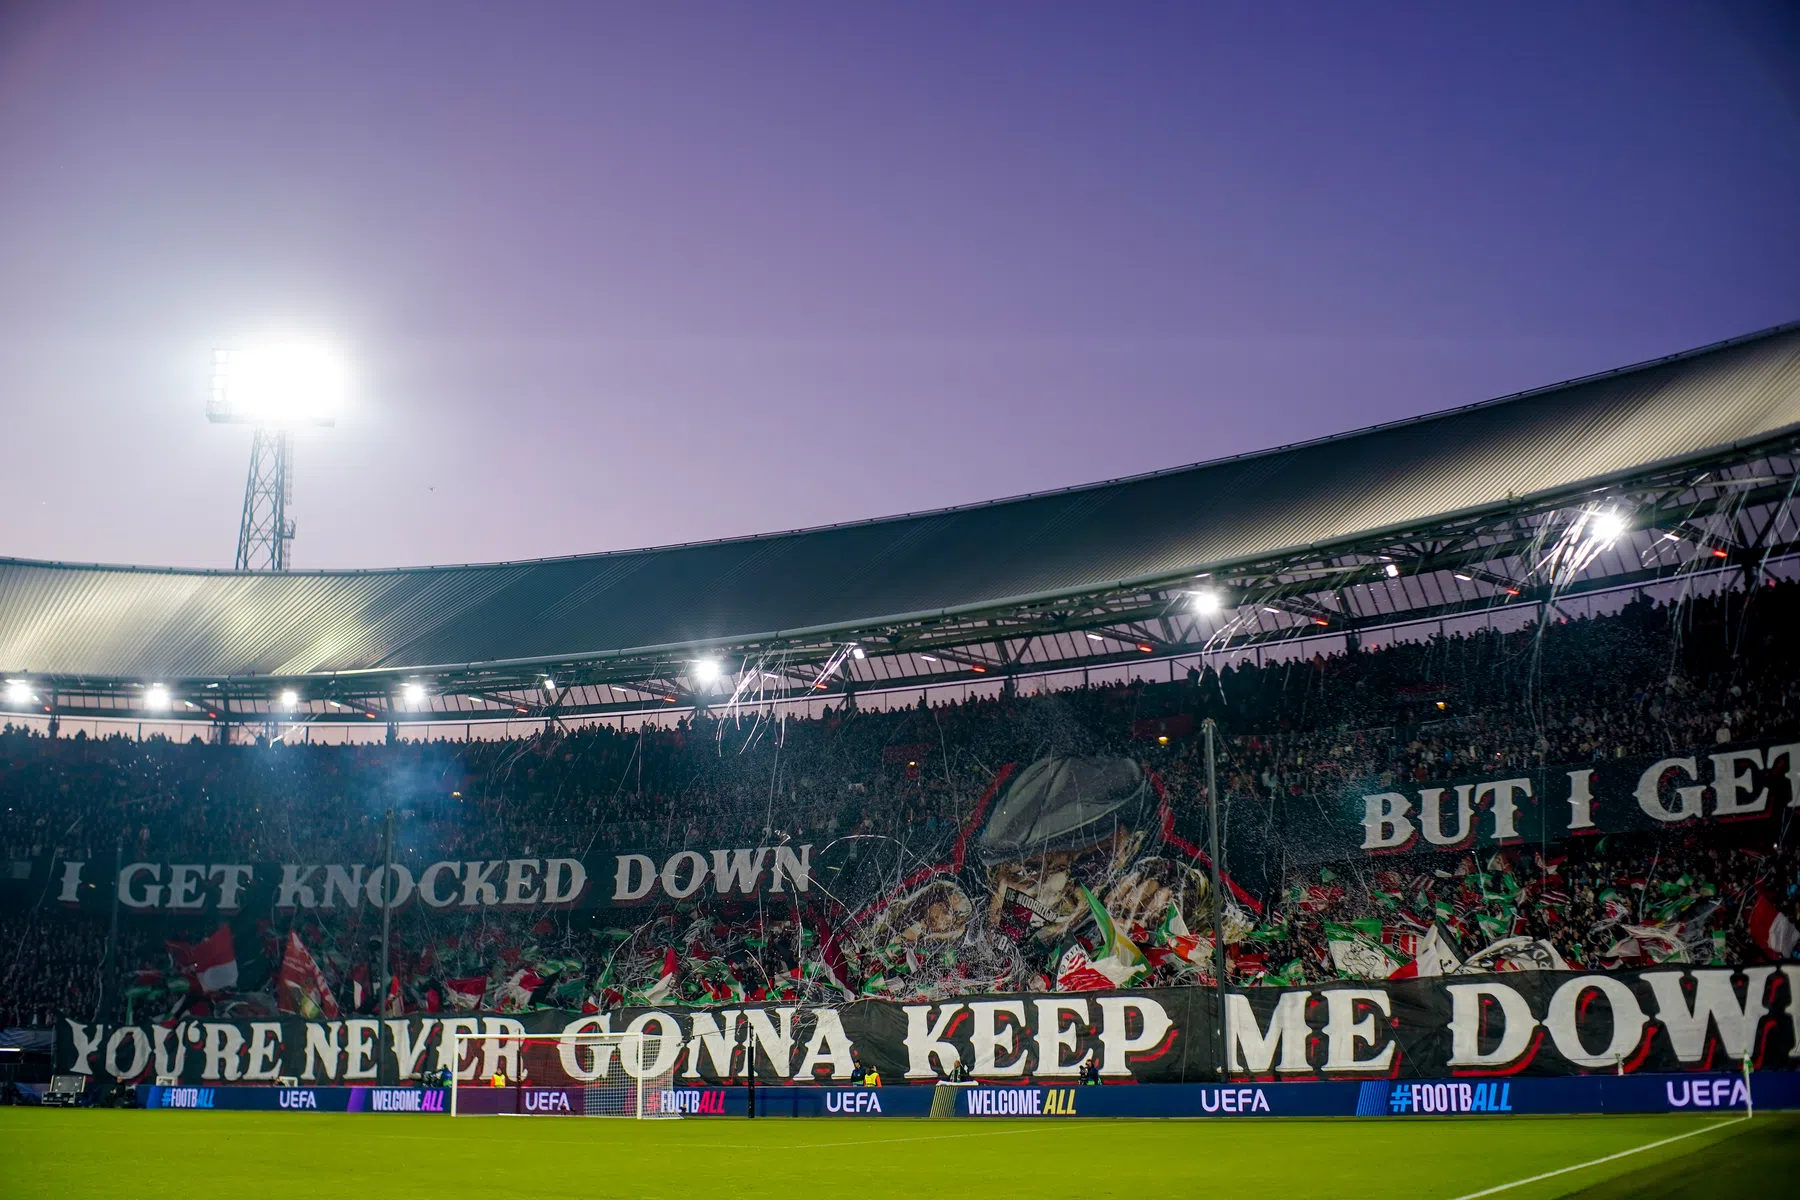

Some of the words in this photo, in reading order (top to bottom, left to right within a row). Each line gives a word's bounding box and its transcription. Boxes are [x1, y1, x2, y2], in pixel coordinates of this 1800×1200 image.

[1360, 777, 1533, 849] BUT
[1567, 769, 1594, 831] I
[57, 861, 86, 902] I
[118, 863, 254, 907] GET
[276, 857, 587, 909] KNOCKED
[613, 844, 814, 899] DOWN
[66, 1018, 282, 1080] YOU'RE
[305, 1016, 529, 1082] NEVER
[557, 1008, 855, 1081] GONNA
[903, 995, 1173, 1079] KEEP
[1217, 989, 1396, 1074] ME
[162, 1088, 215, 1108] #FOOTBALL
[279, 1091, 317, 1108] UEFA
[371, 1091, 421, 1111] WELCOME
[422, 1091, 444, 1111] ALL
[525, 1092, 571, 1111] UEFA
[646, 1090, 726, 1114] #FOOTBALL
[826, 1092, 882, 1113] UEFA
[967, 1090, 1041, 1115] WELCOME
[1043, 1091, 1077, 1115] ALL
[1201, 1089, 1270, 1112] UEFA
[1390, 1081, 1513, 1113] #FOOTBALL
[1667, 1080, 1753, 1106] UEFA
